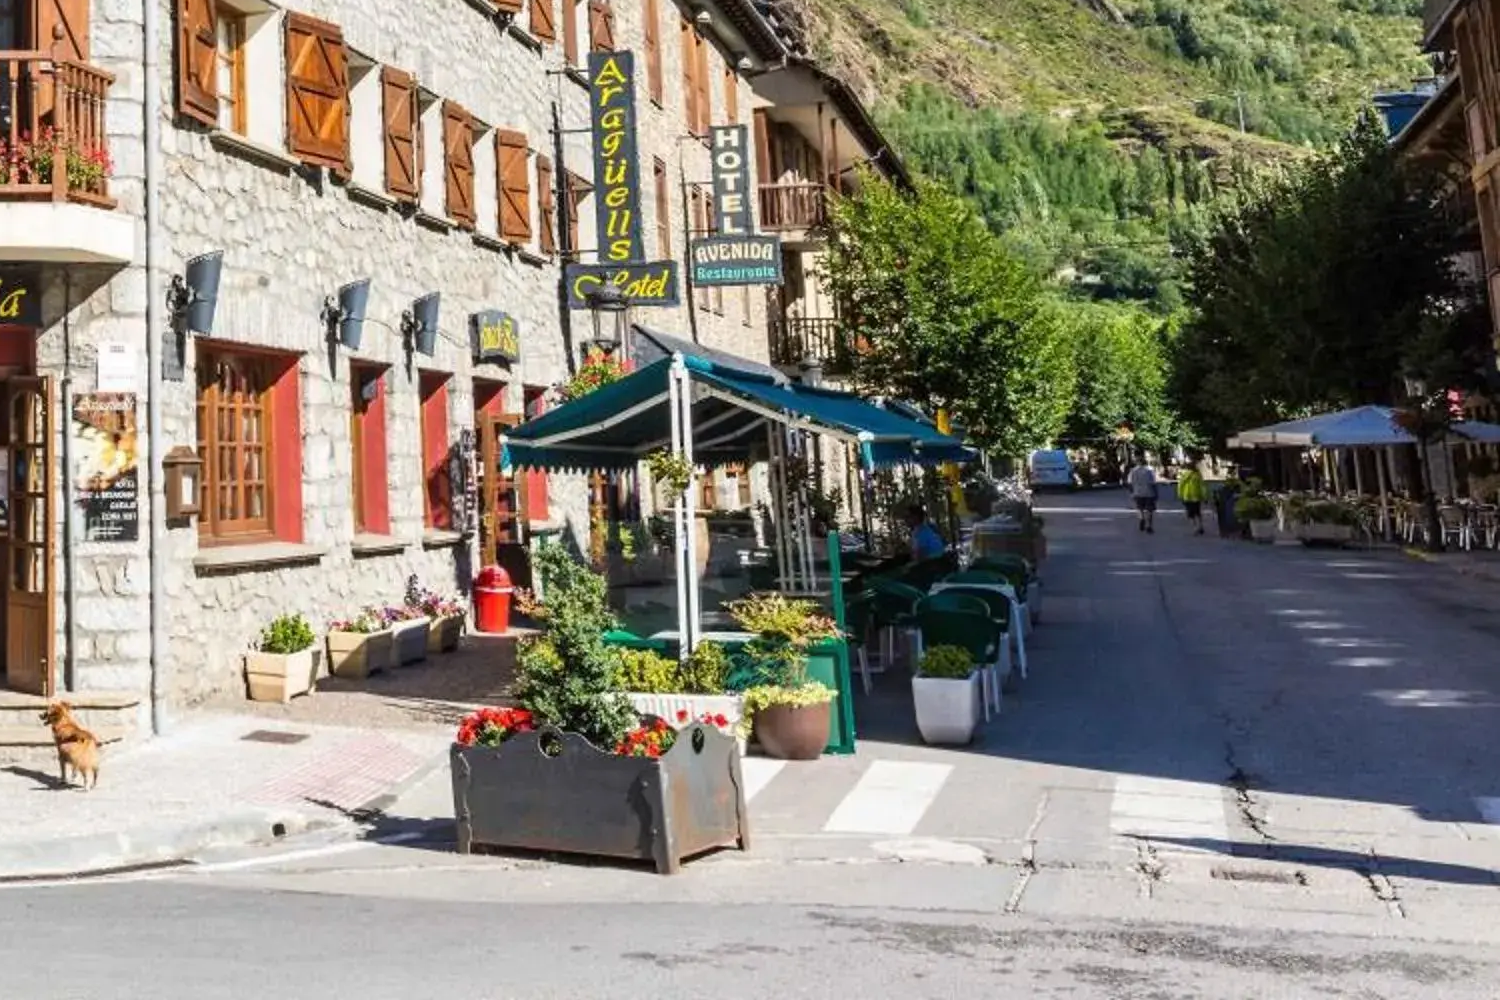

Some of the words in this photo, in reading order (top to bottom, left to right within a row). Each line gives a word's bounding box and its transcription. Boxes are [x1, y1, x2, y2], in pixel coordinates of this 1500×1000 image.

[594, 58, 632, 261] Aragüells
[715, 128, 744, 235] HOTEL
[696, 243, 774, 263] AVENIDA
[697, 266, 776, 281] Restaurante
